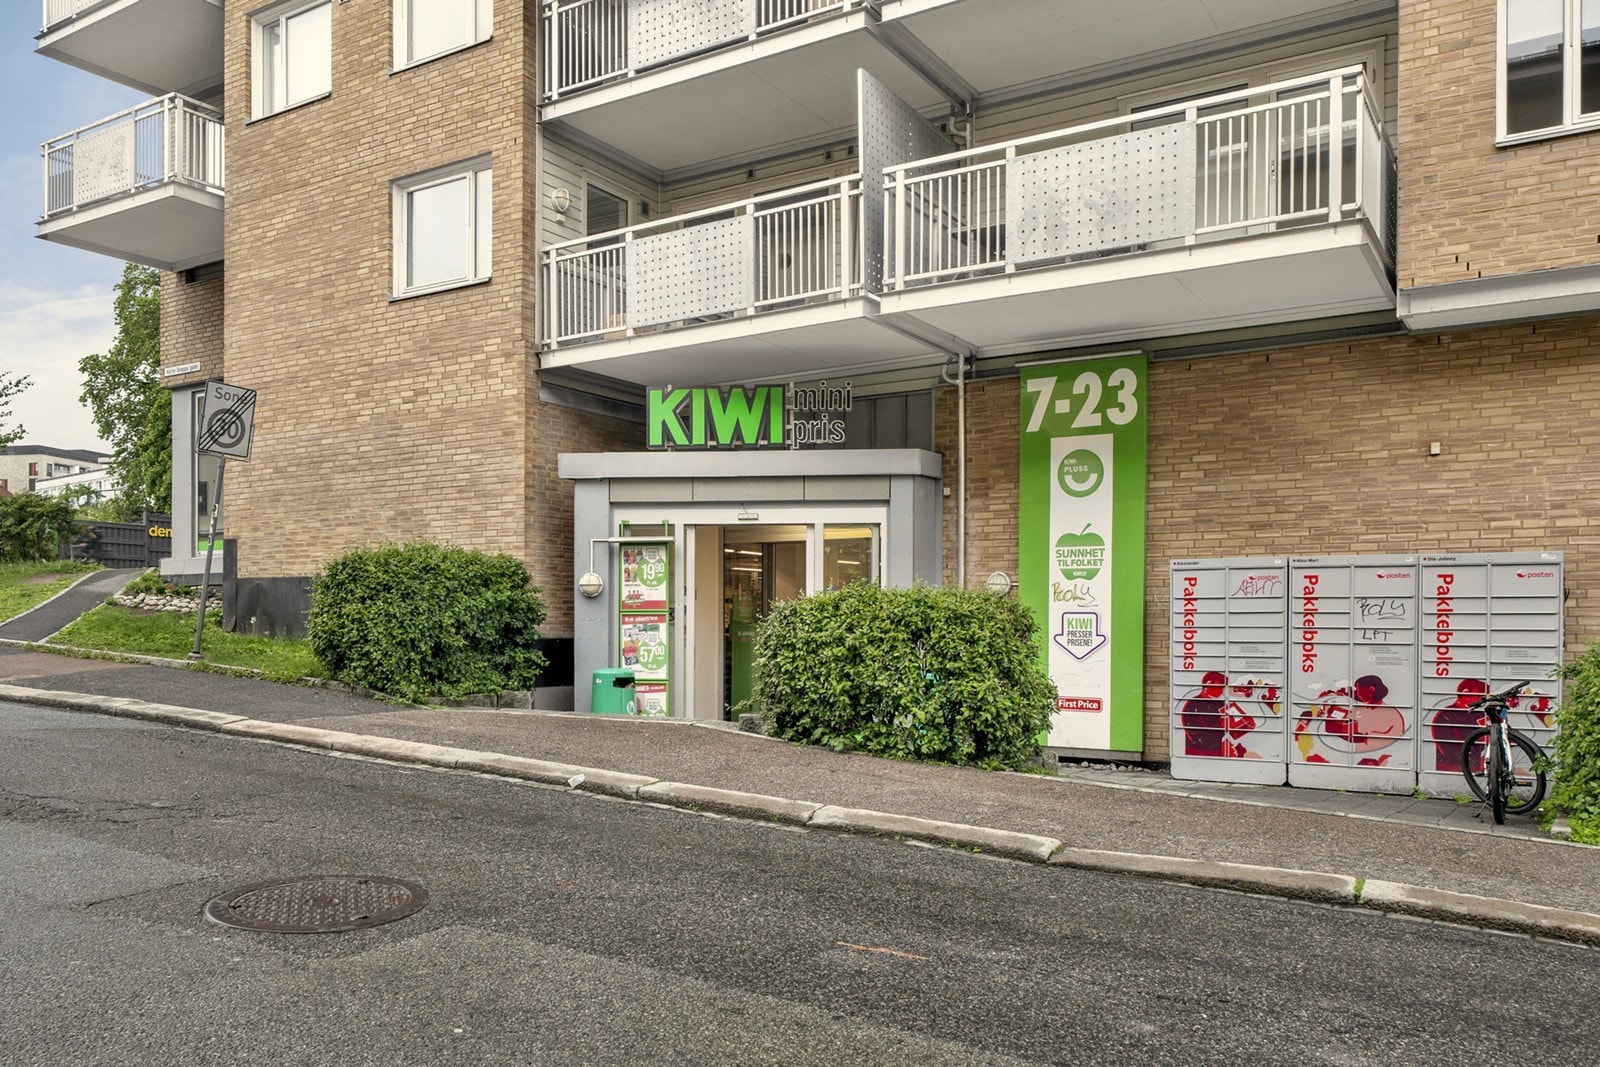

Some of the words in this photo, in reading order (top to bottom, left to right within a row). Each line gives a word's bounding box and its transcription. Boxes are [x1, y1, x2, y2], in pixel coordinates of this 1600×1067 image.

[793, 381, 852, 410] mini
[1026, 368, 1138, 432] 7-23
[647, 385, 786, 449] KIWI
[793, 413, 845, 449] pris
[1064, 465, 1088, 473] PLUSS
[1056, 547, 1105, 559] SUNNHET
[1057, 558, 1070, 568] TIL
[1070, 558, 1104, 568] FOLKET
[1257, 574, 1279, 582] posten
[1386, 572, 1411, 580] posten
[1527, 571, 1554, 579] posten
[1067, 618, 1092, 630] KIWI
[1183, 576, 1198, 671] Pakkeboks
[1302, 575, 1319, 673] Pakkeboks
[1436, 574, 1454, 677] Pakkeboks
[1067, 630, 1092, 639] PRESSER
[1067, 638, 1093, 647] PRISENE!
[1058, 699, 1077, 709] First
[1078, 700, 1098, 710] Price
